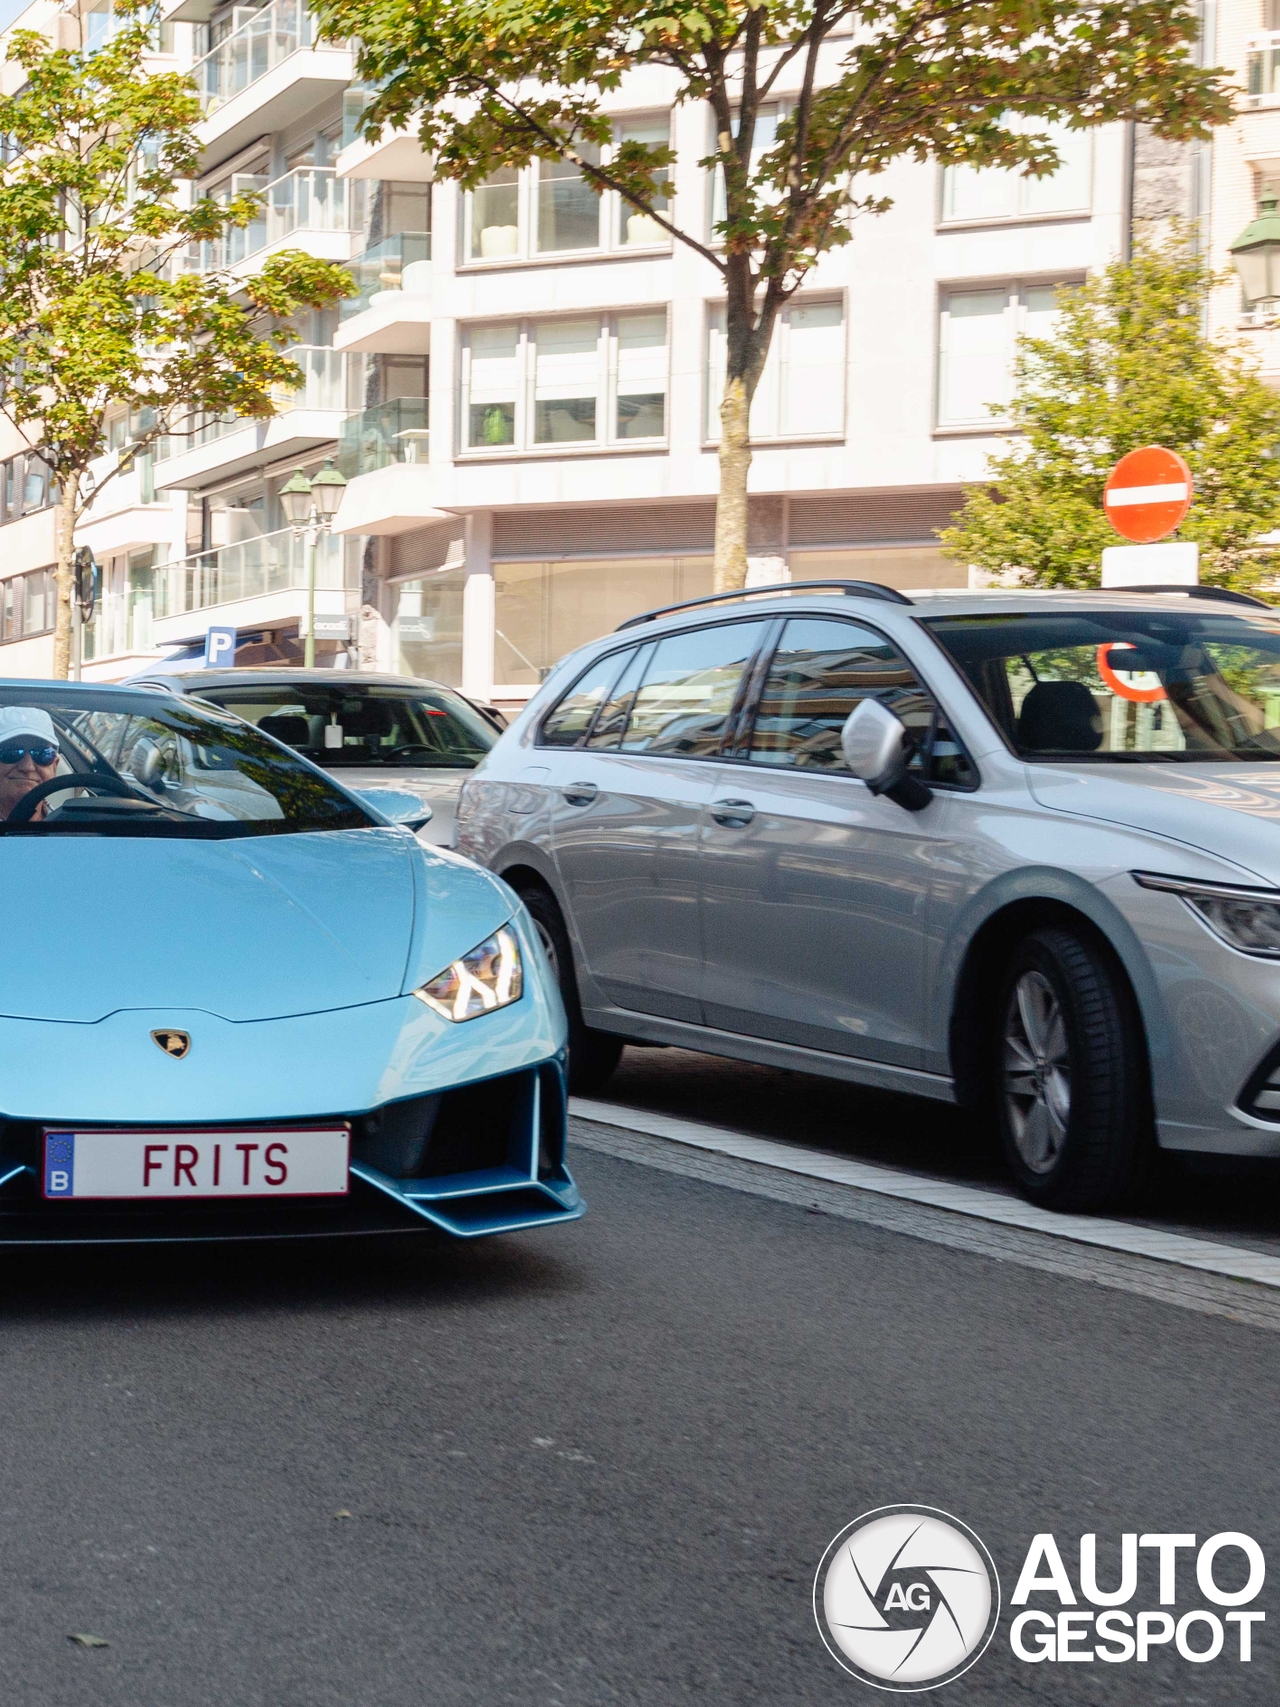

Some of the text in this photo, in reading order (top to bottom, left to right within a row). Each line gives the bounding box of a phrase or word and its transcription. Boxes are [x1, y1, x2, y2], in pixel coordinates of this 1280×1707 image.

[209, 632, 232, 663] P
[142, 1142, 289, 1187] FRITS
[50, 1170, 69, 1192] B
